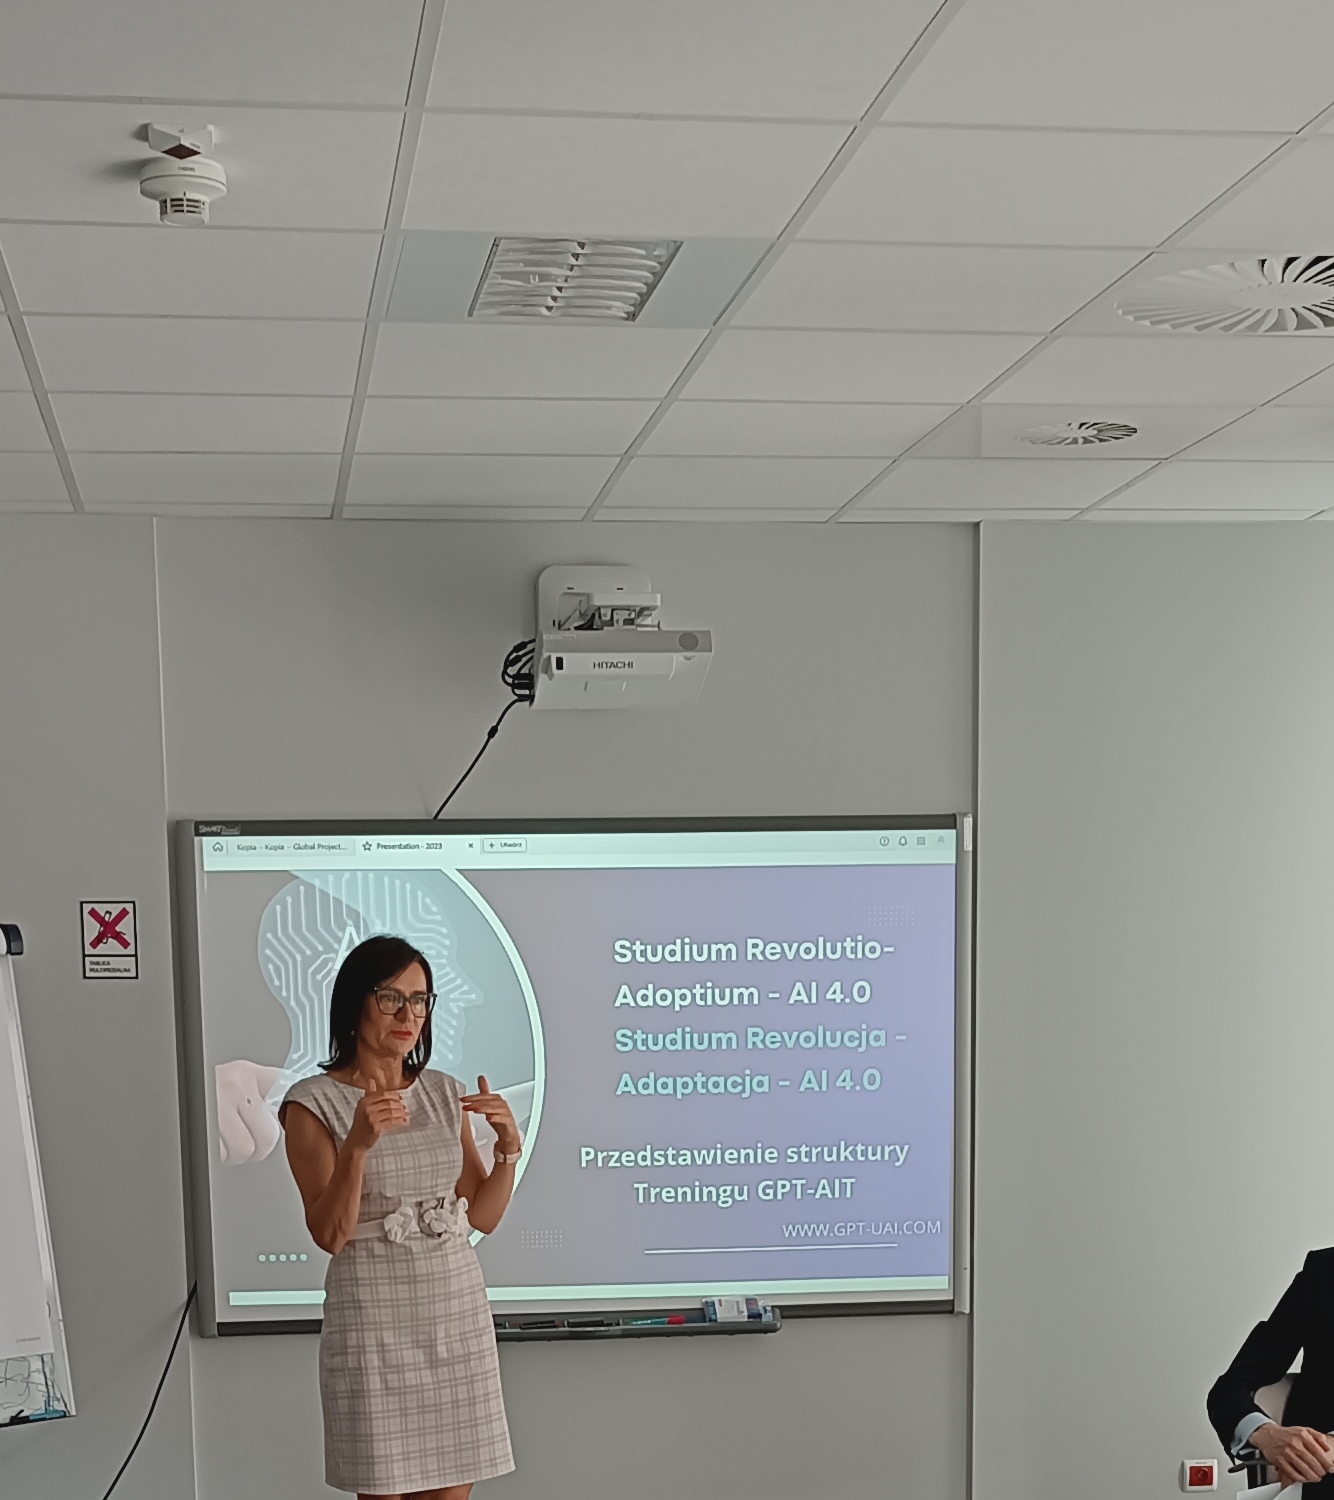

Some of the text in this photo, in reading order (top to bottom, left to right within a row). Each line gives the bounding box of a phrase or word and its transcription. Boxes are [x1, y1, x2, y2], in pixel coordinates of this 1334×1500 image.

[593, 661, 634, 669] HITACHI
[376, 842, 419, 850] Presentation
[613, 935, 896, 963] Studium Revolutio-
[614, 981, 760, 1012] Adoptium
[788, 981, 818, 1005] AI
[825, 980, 872, 1005] 4.0
[615, 1026, 738, 1052] Studium
[747, 1023, 887, 1053] Revolucja
[615, 1069, 771, 1100] Adaptacja
[799, 1070, 828, 1092] AI
[836, 1068, 882, 1092] 4.0
[579, 1140, 910, 1169] Przedstawienie struktury
[633, 1177, 856, 1208] Treningu GPT-AIT
[782, 1219, 942, 1238] WWW.GPT-UAI.COM
